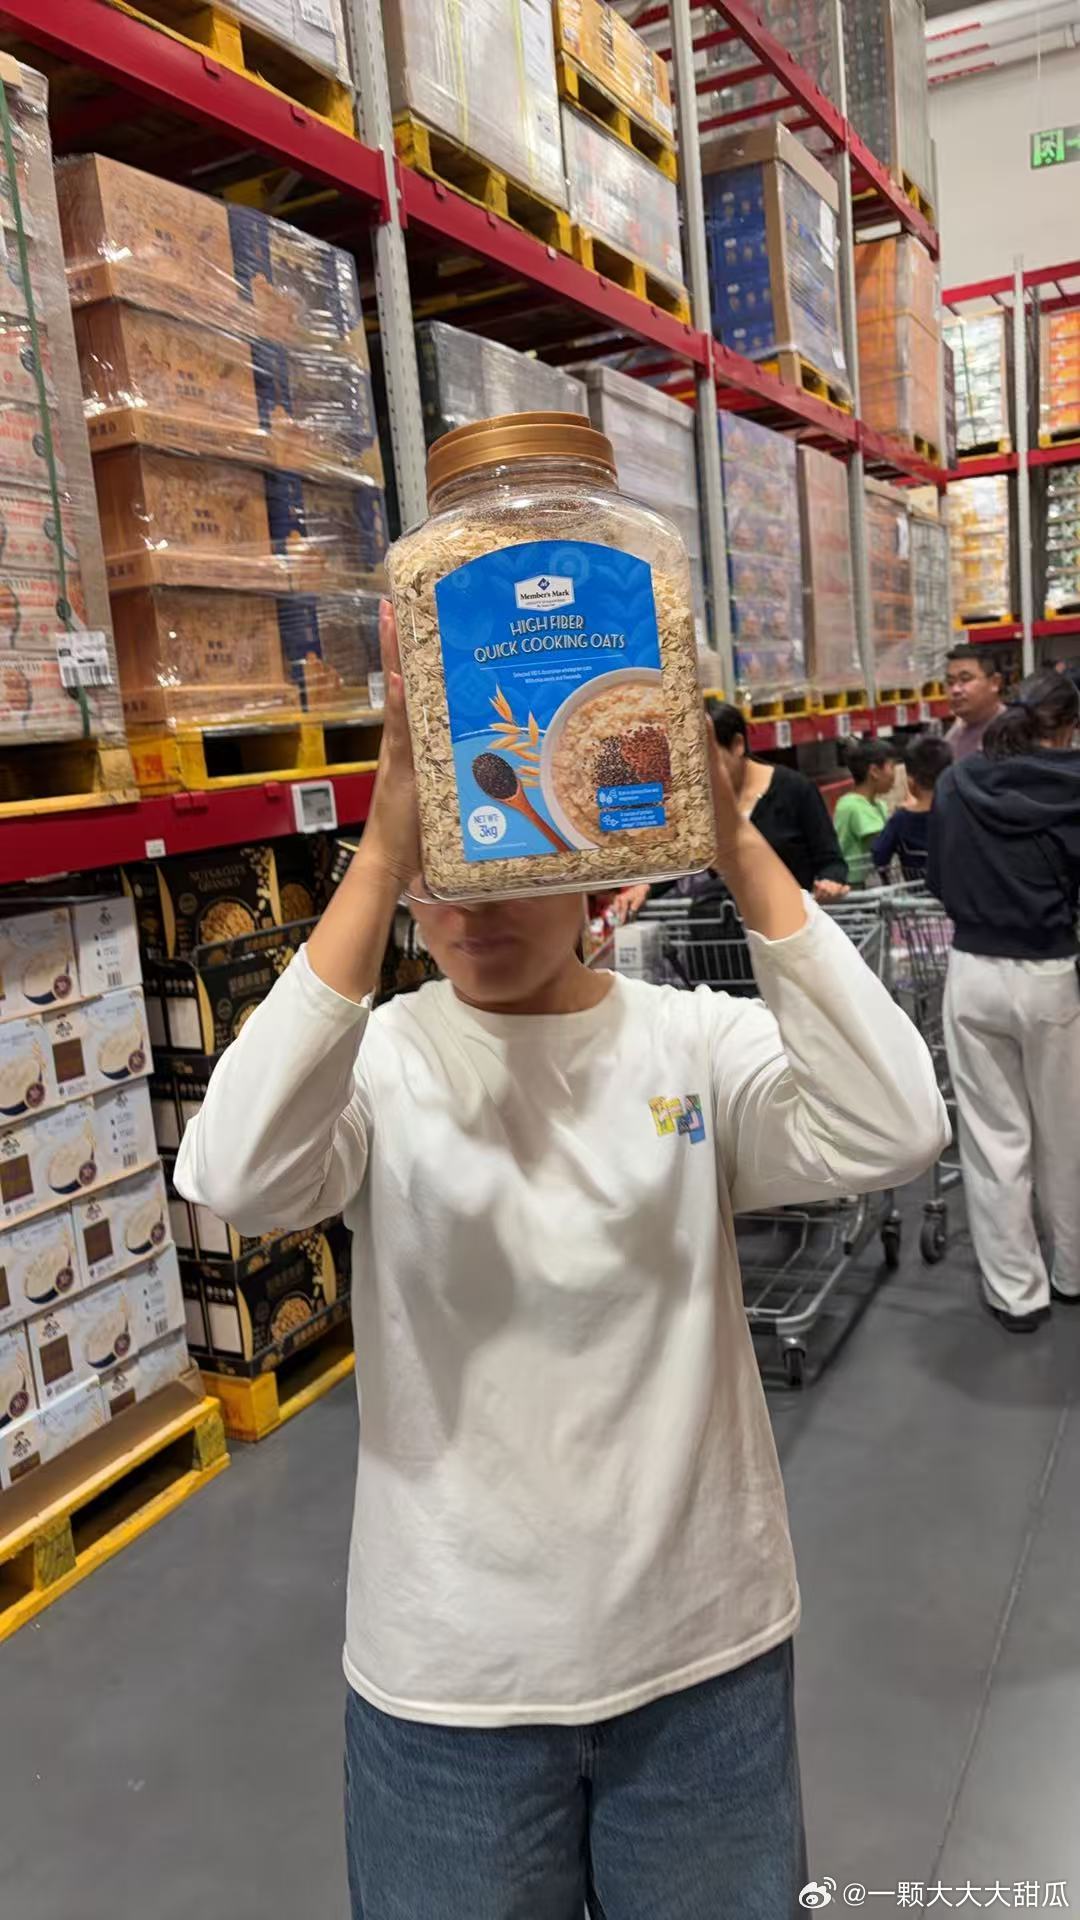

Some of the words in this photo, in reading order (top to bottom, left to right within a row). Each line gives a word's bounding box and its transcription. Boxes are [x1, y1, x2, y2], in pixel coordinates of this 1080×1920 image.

[520, 592, 551, 600] Member's
[552, 589, 570, 597] Mark
[509, 615, 548, 636] HIGH
[550, 614, 584, 630] FIBER
[473, 640, 518, 663] QUICK
[521, 633, 588, 653] COOKING
[590, 633, 625, 649] OATS
[473, 815, 486, 823] NET
[479, 825, 498, 839] 3kg
